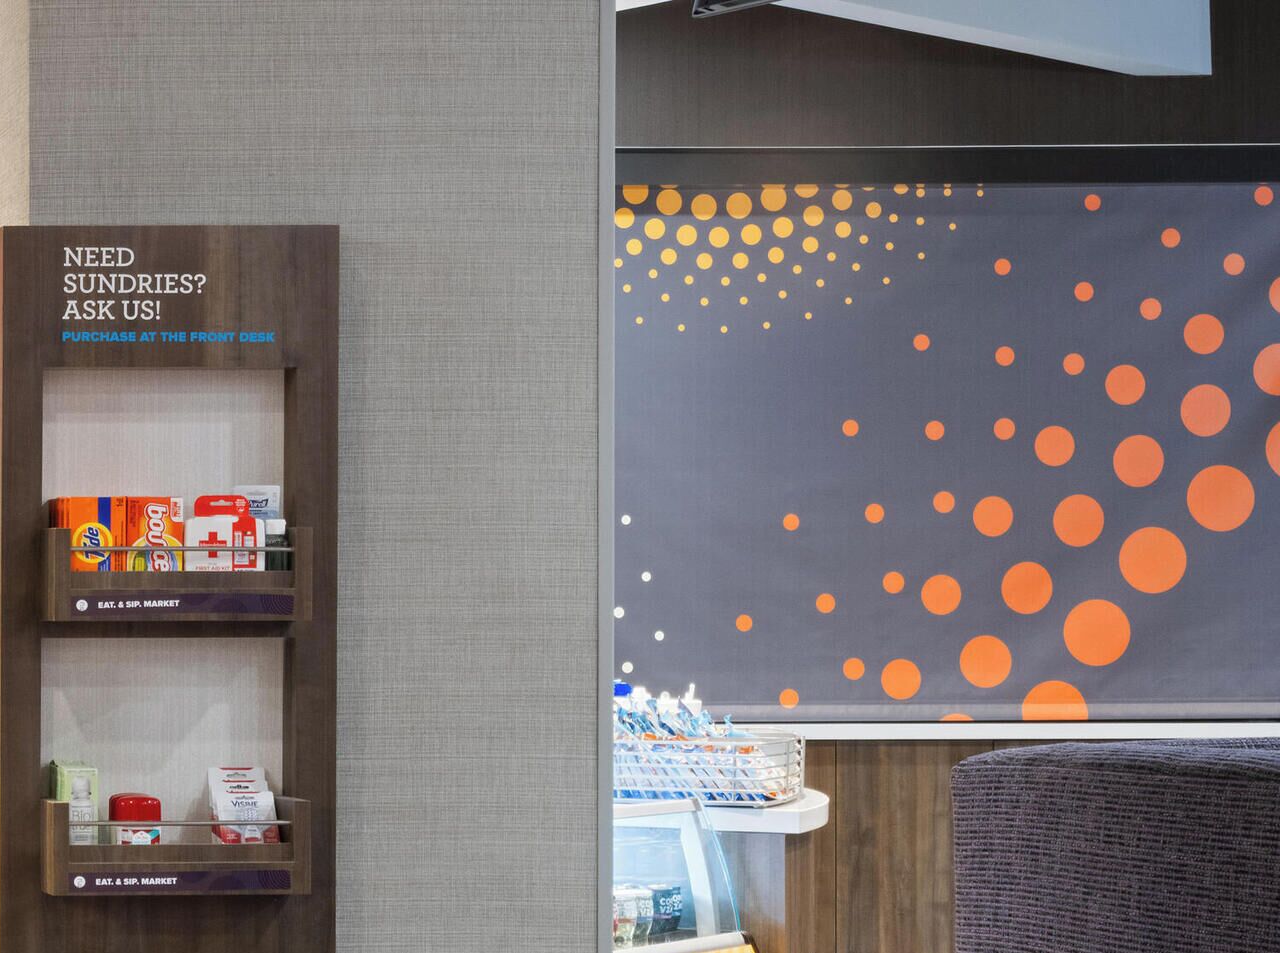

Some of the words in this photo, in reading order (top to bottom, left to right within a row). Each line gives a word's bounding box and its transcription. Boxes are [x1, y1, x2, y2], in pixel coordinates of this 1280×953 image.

[63, 247, 135, 268] NEED
[63, 273, 207, 294] SUNDRIES?
[62, 300, 116, 320] ASK
[122, 300, 161, 320] US!
[62, 331, 136, 342] PURCHASE
[140, 332, 159, 342] AT
[161, 332, 187, 342] THE
[190, 331, 236, 342] FRONT
[239, 331, 275, 342] DESK
[98, 601, 117, 609] EAT.
[143, 600, 180, 608] MARKET
[96, 878, 114, 886] EAT.
[141, 877, 178, 885] MARKET
